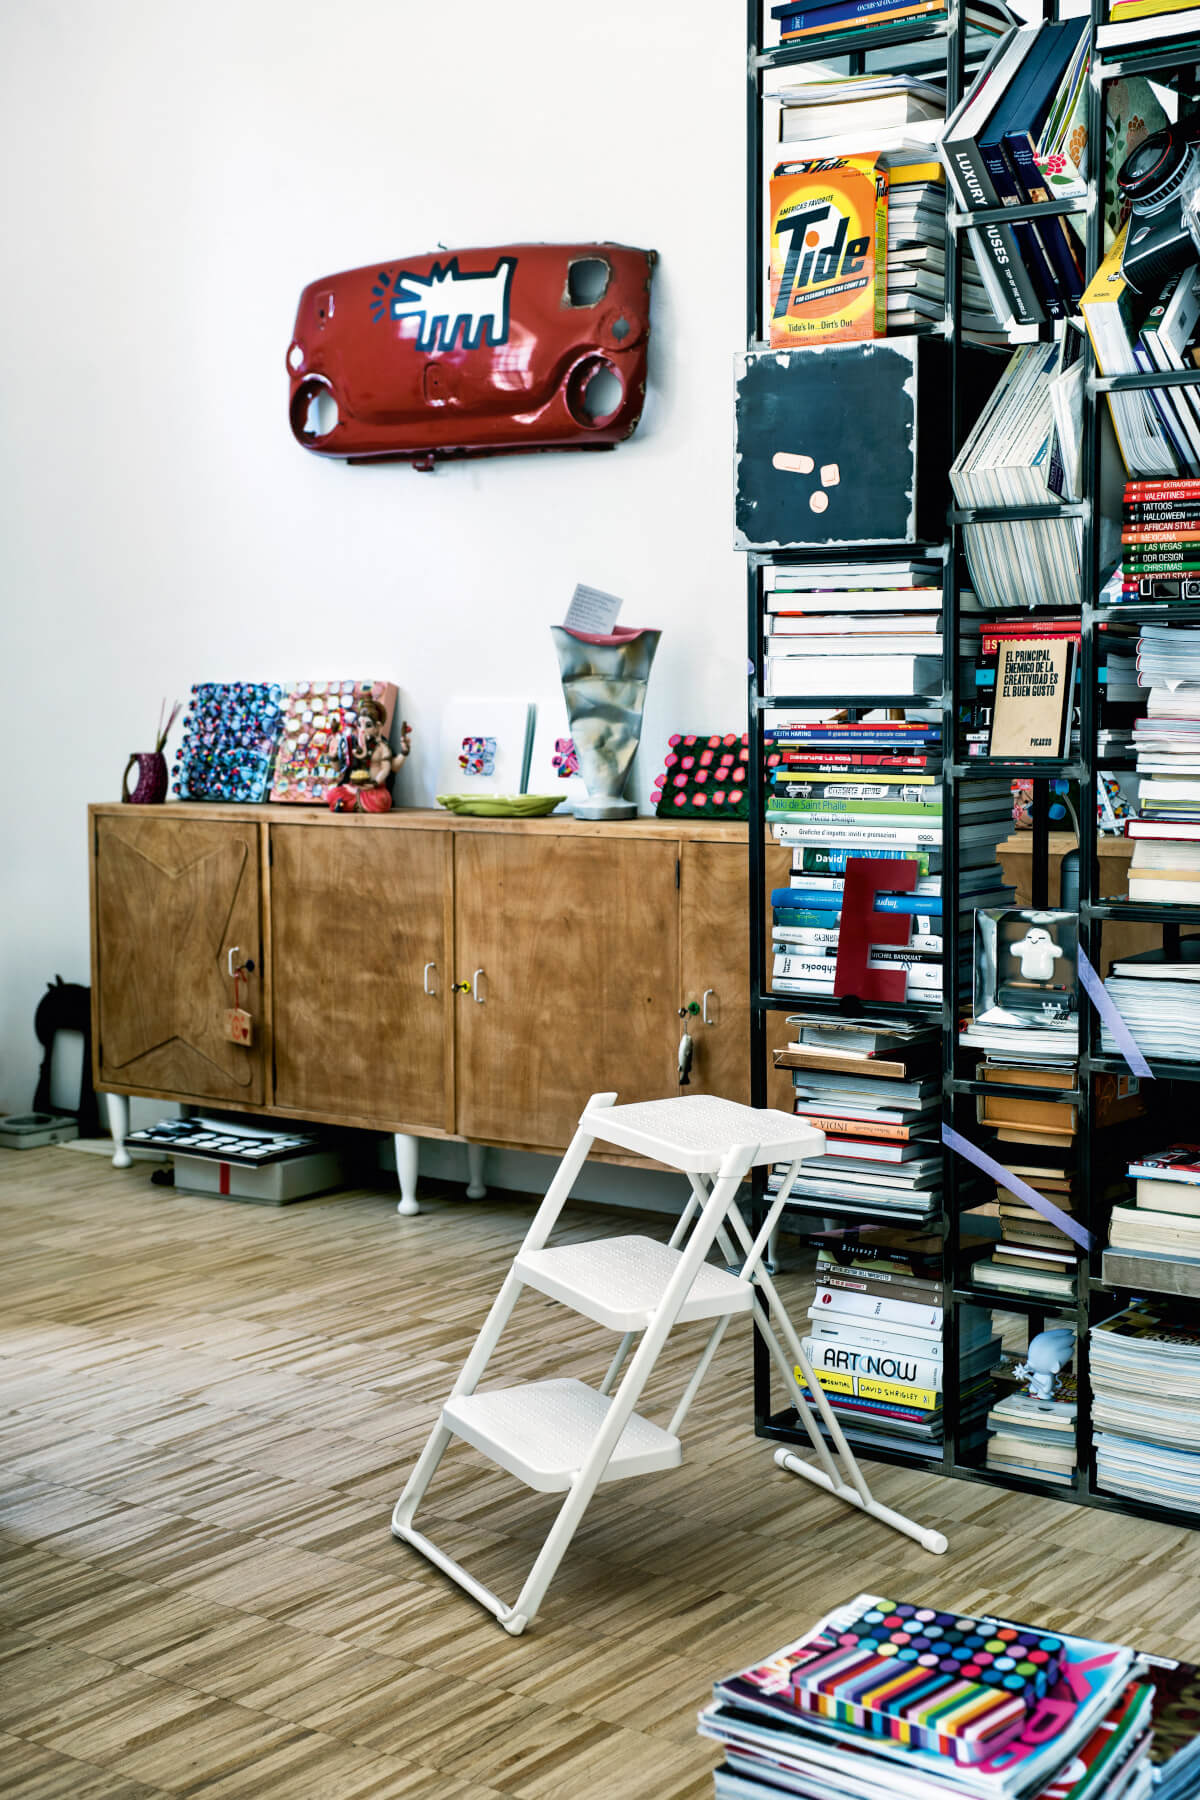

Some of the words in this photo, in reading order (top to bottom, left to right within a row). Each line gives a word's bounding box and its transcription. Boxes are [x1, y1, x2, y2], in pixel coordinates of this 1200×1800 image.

[809, 157, 850, 174] Tide
[779, 201, 807, 216] AMERICA'S
[808, 194, 834, 207] FAVORITE
[956, 152, 988, 206] LUXURY
[984, 224, 1010, 264] USES
[773, 205, 870, 319] Tide
[796, 296, 805, 304] FOR
[804, 291, 826, 302] CLEANING
[844, 282, 859, 292] COUNT
[788, 324, 807, 332] Tide's
[1144, 491, 1185, 500] VALENTINES
[1142, 502, 1173, 511] TATTOOS
[1143, 512, 1186, 521] HALLOWEEN
[1144, 522, 1174, 532] AFRICAN
[1174, 521, 1196, 530] STYLE
[1140, 533, 1177, 541] MEXICANA
[1144, 544, 1158, 552] LAS
[1159, 542, 1183, 551] VEGAS
[1158, 553, 1184, 562] DESIGN
[1143, 563, 1183, 572] CHRISTMAS
[1172, 572, 1193, 580] STYLE
[1006, 651, 1014, 662] EL
[1015, 650, 1051, 662] PRINCIPAL
[1005, 662, 1035, 674] ENEMIGO
[1036, 662, 1044, 673] DE
[1045, 660, 1054, 673] LA
[1004, 674, 1048, 686] CREATIVIDAD
[1050, 673, 1059, 685] ES
[1002, 686, 1011, 698] EL
[1012, 685, 1031, 698] BUEN
[1032, 684, 1055, 697] GUSTO
[1030, 738, 1052, 747] PICASSO
[772, 800, 788, 809] Niki
[788, 801, 800, 809] de
[800, 800, 821, 810] Saint
[822, 801, 847, 811] Phalle
[799, 828, 820, 836] Grafiche
[816, 854, 842, 863] David
[824, 1348, 860, 1371] ART
[866, 1359, 918, 1382] NOW
[860, 1384, 882, 1396] DAVID
[884, 1385, 919, 1401] SHRIGLEY
